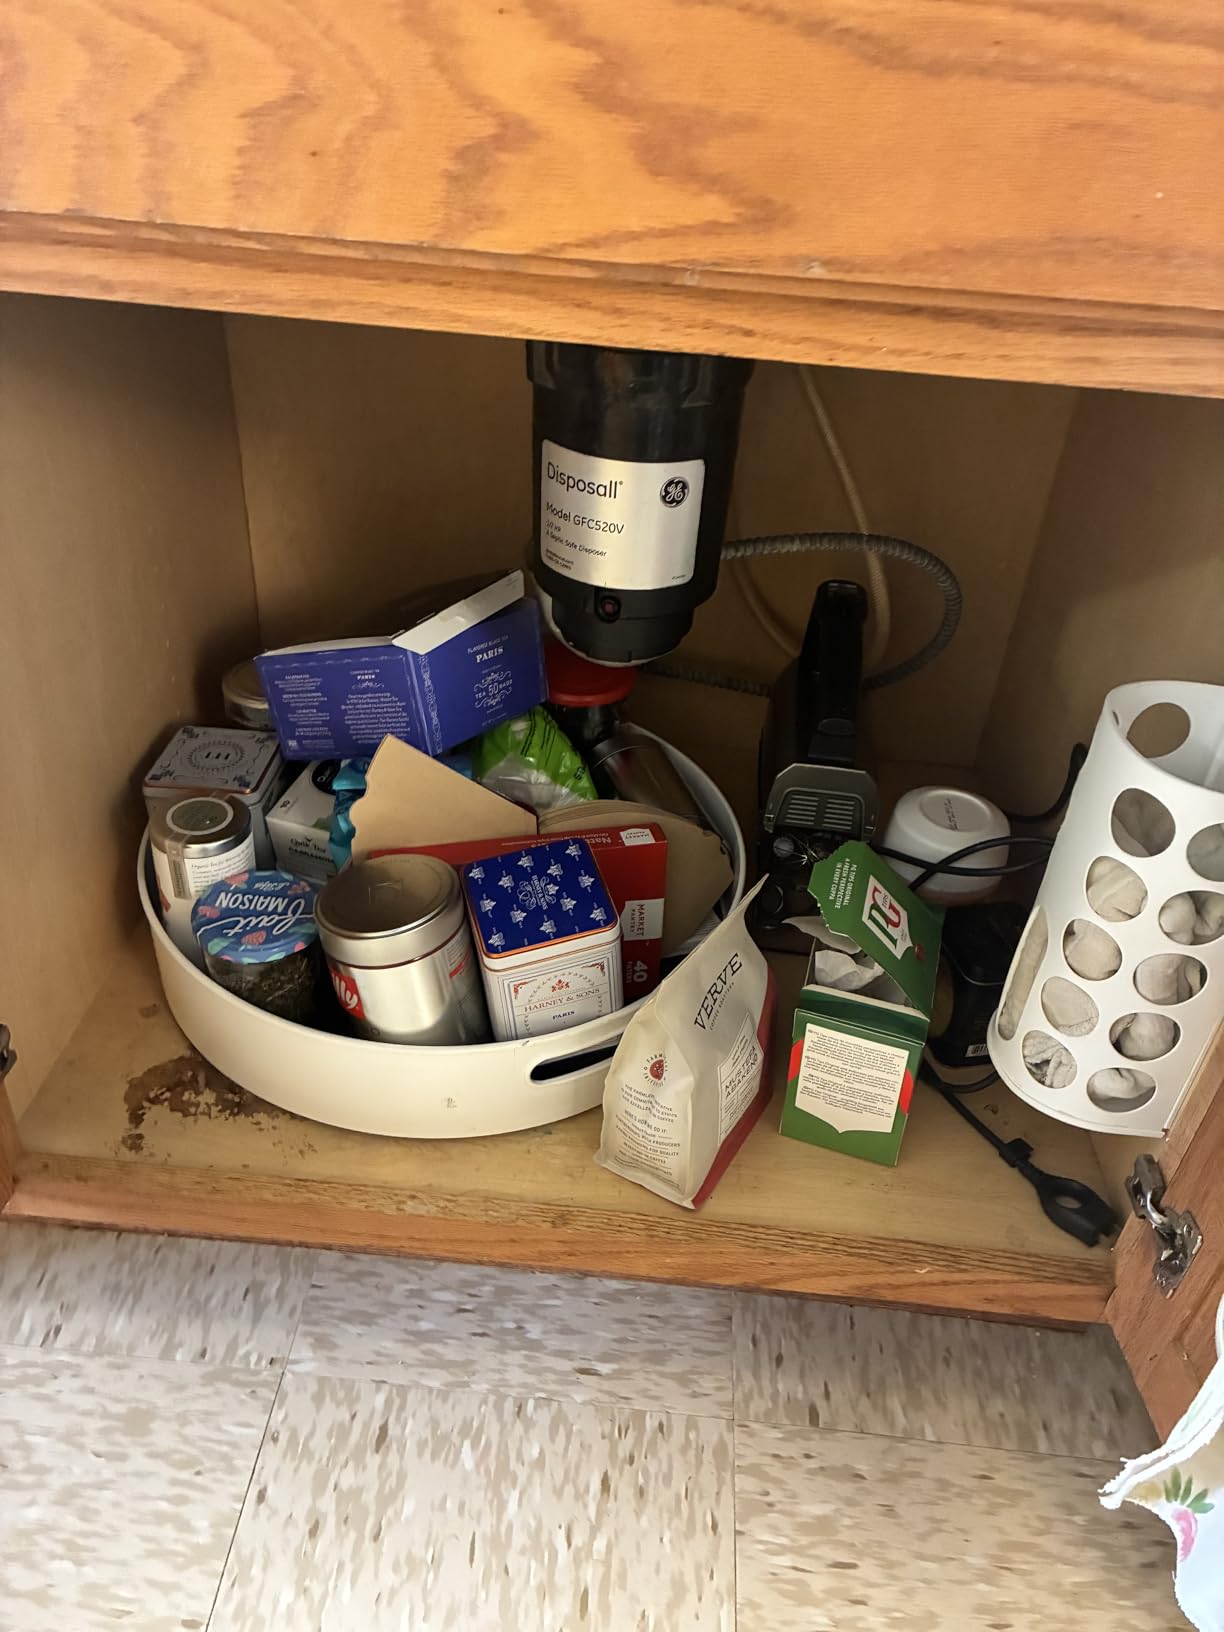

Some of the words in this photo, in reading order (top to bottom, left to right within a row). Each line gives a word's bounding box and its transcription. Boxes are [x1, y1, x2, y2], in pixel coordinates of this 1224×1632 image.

[546, 501, 571, 523] Model
[573, 514, 624, 534] GFC520V
[565, 539, 577, 550] Safe
[476, 645, 504, 663] PARIS
[475, 691, 486, 700] TEA
[488, 682, 499, 696] 50
[499, 679, 513, 689] BAGS
[833, 868, 842, 884] EVERY
[841, 862, 850, 877] FRESH
[848, 871, 856, 882] TIPS
[215, 891, 288, 911] MAISON
[829, 884, 838, 900] CUPPA
[834, 876, 847, 909] PERSPECTIVE
[842, 882, 854, 906] ORIGINAL
[637, 903, 645, 937] MARKET
[633, 960, 648, 983] 40
[524, 998, 565, 1013] HARNEY
[566, 994, 575, 1003] &
[575, 987, 601, 1000] SONS
[694, 952, 743, 1030] VERVE
[552, 1009, 576, 1021] PARIS
[659, 1149, 679, 1157] QUALITY
